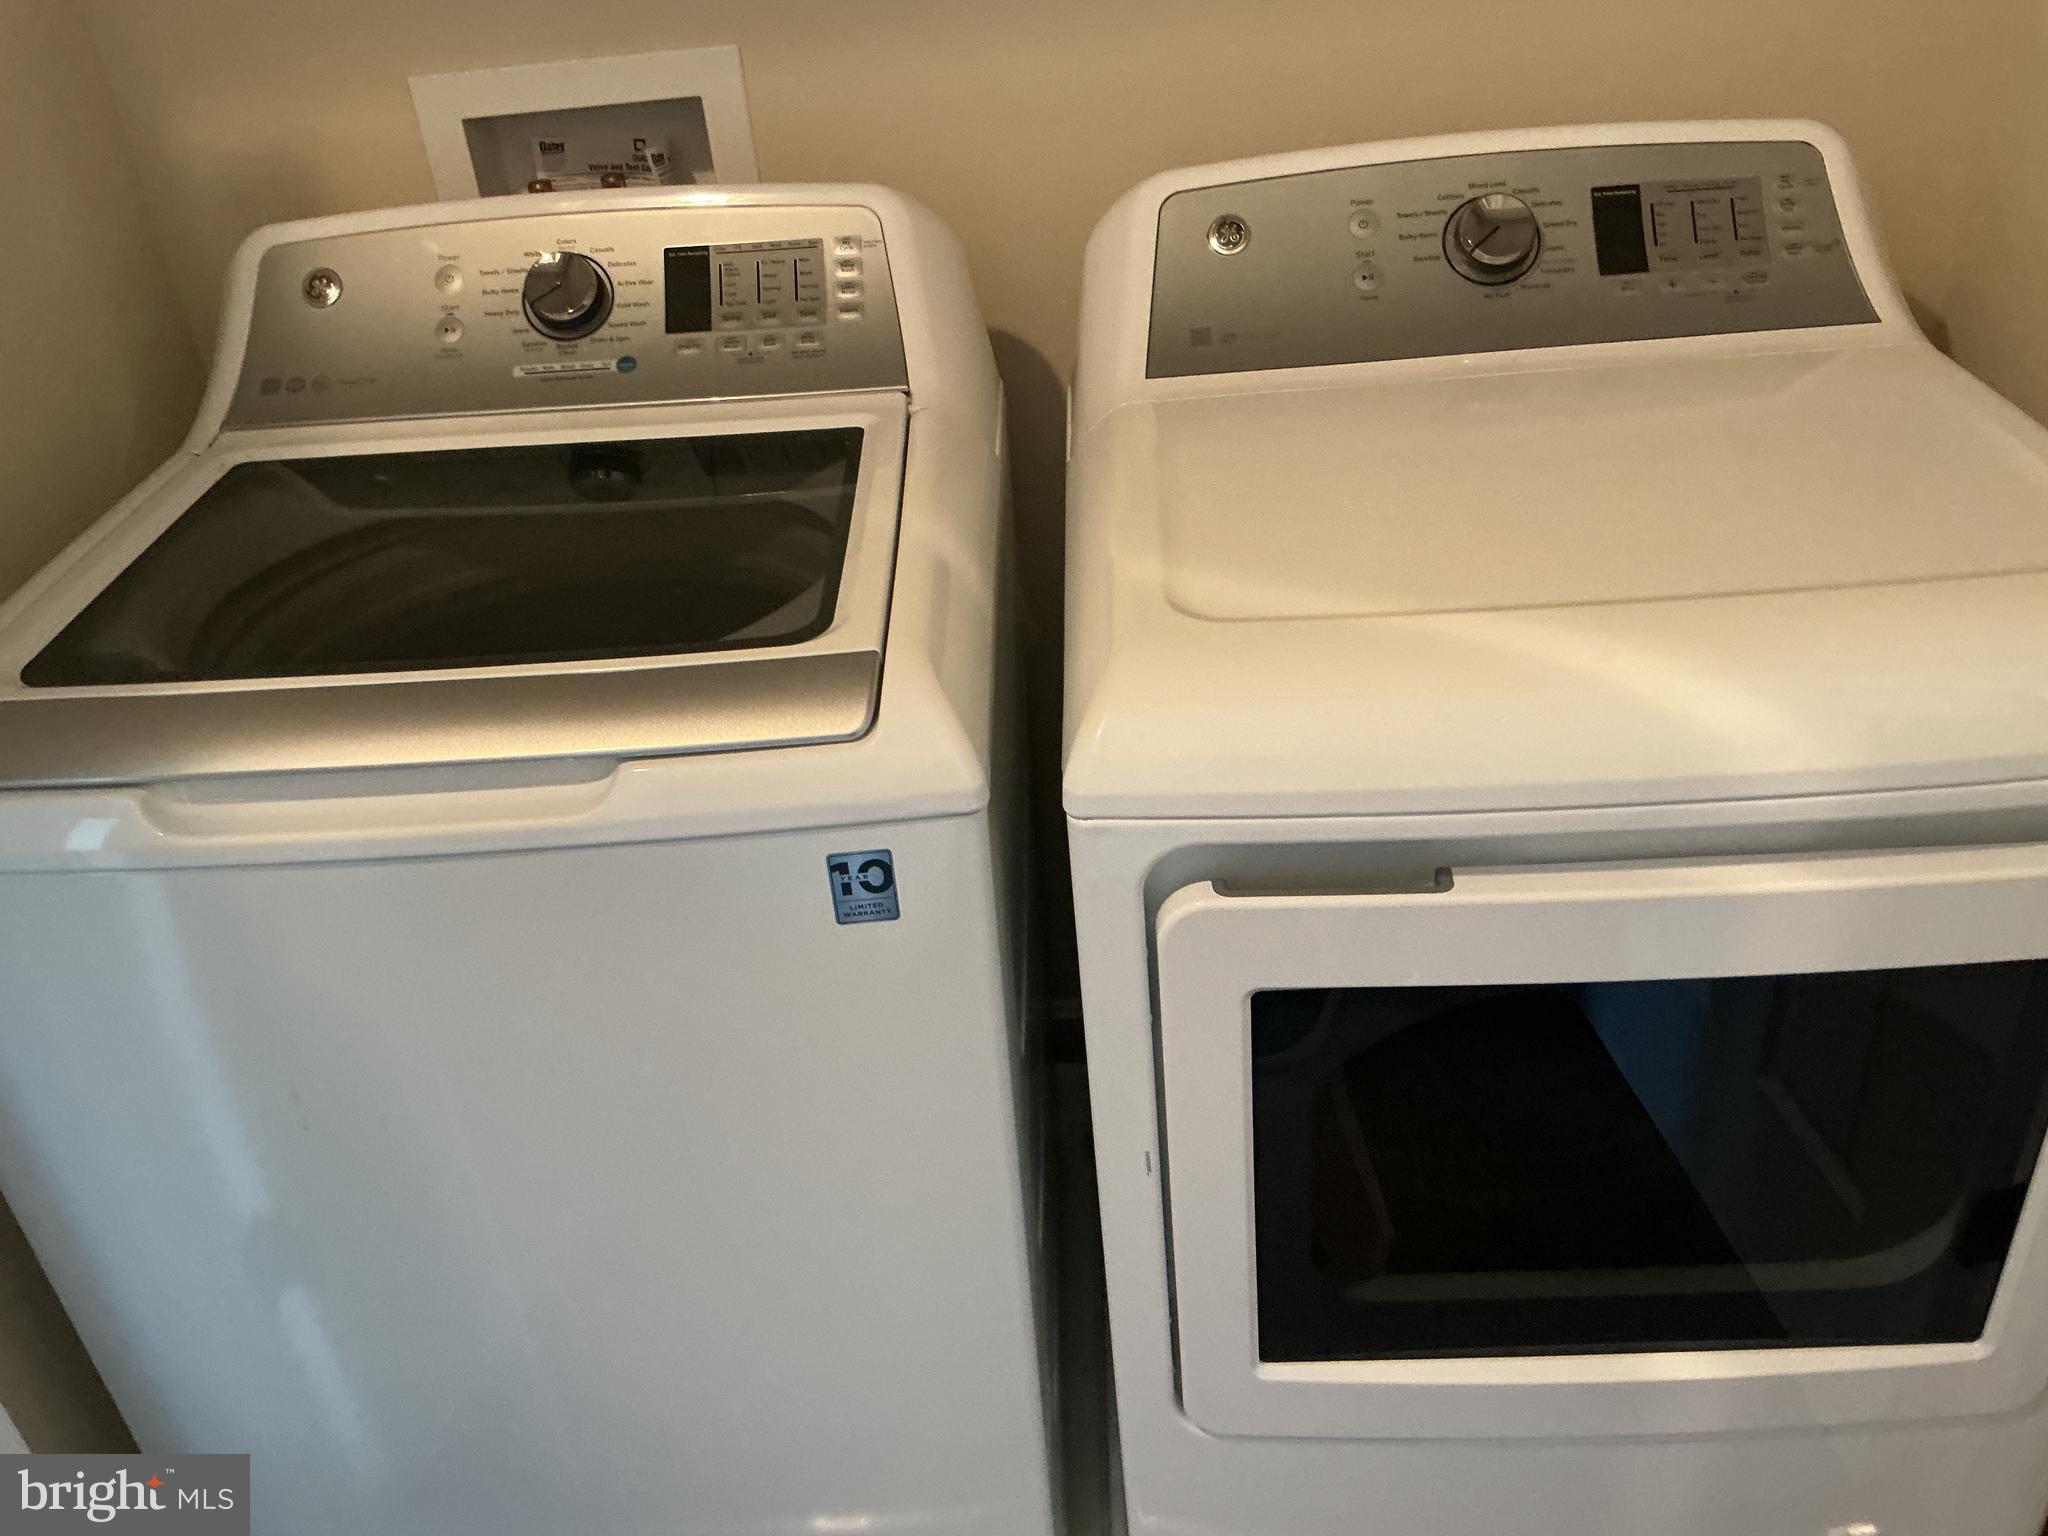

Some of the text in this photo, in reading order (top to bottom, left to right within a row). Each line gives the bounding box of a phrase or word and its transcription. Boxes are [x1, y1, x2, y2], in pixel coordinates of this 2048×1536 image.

[830, 859, 893, 896] 10
[840, 874, 869, 882] YEAR
[849, 903, 884, 911] LIMITED
[843, 908, 892, 918] WARRANTY
